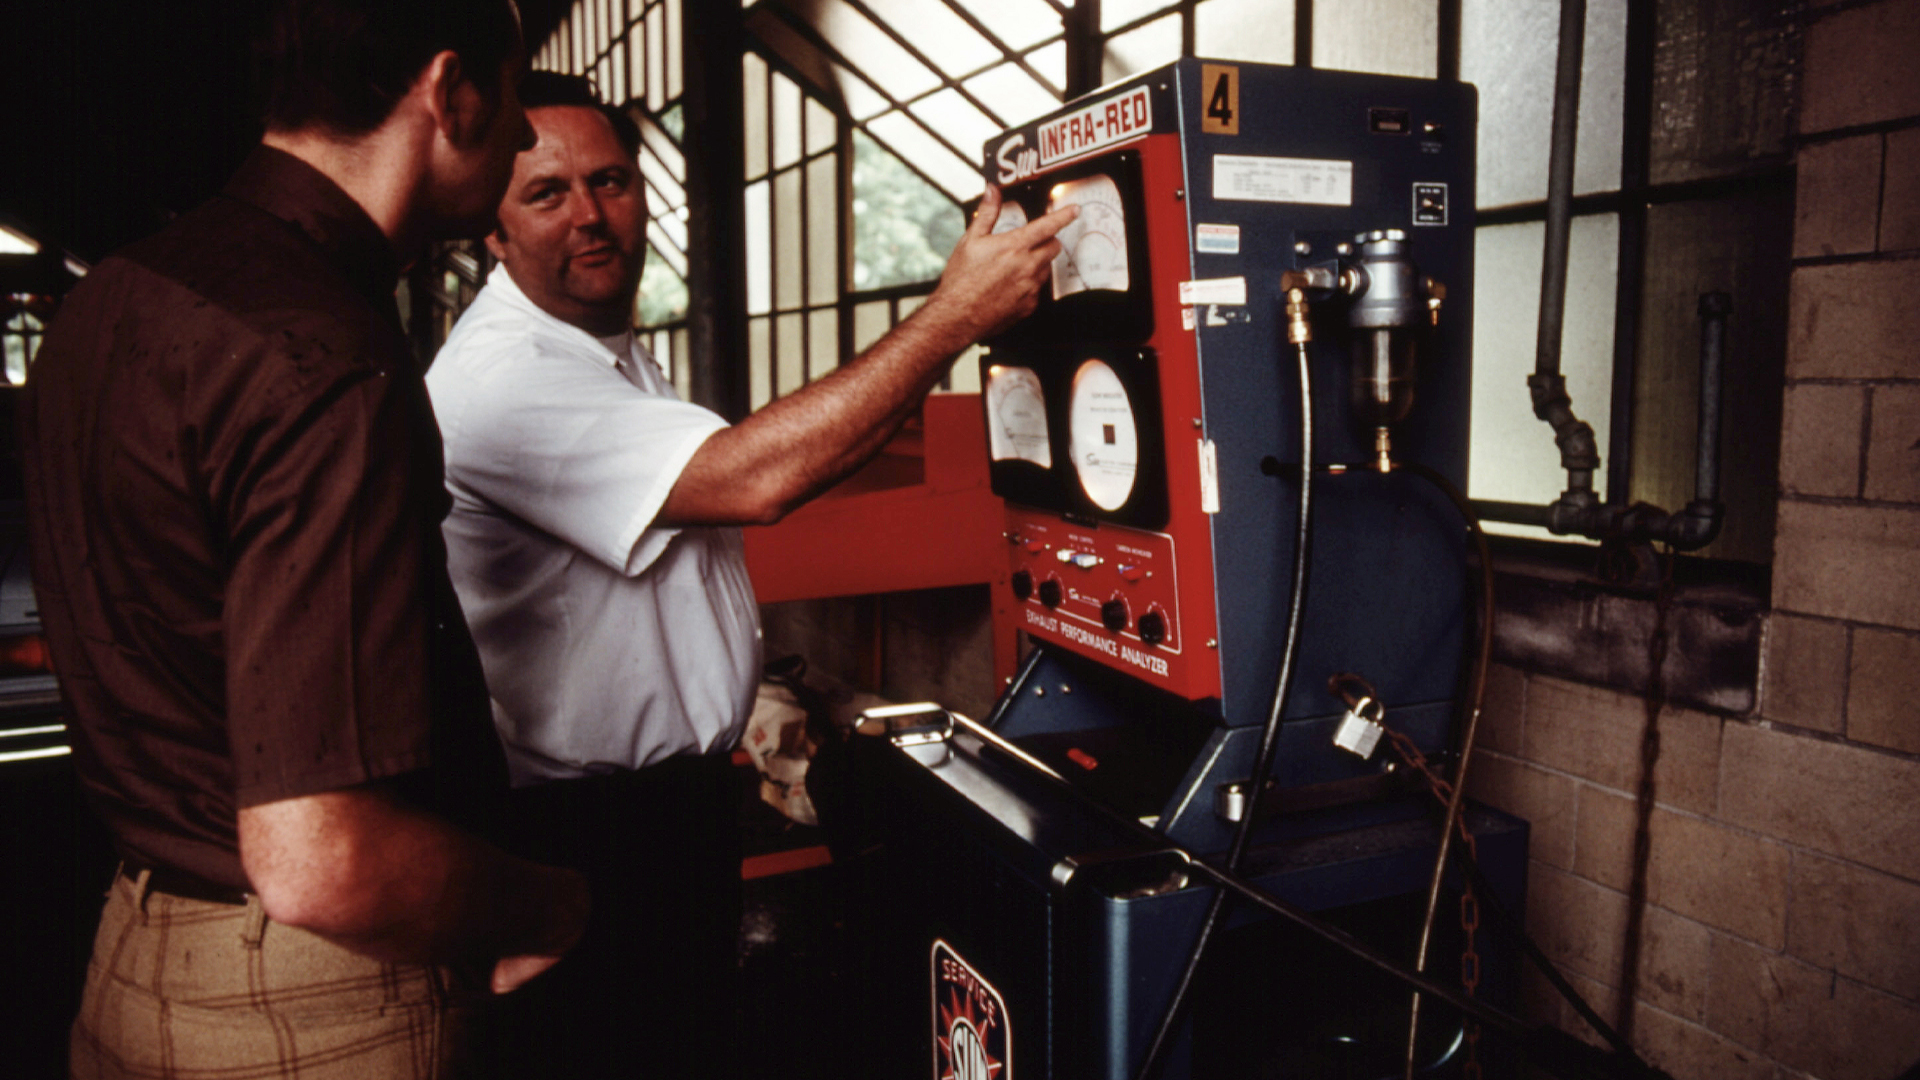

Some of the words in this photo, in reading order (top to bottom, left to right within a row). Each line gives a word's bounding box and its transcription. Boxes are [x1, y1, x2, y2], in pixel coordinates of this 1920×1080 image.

[1208, 73, 1232, 126] 4
[997, 133, 1039, 185] Sun
[1041, 91, 1148, 160] INFRA-RED
[1026, 608, 1058, 632] EXHAUST
[1061, 621, 1119, 657] PERFORMANCE
[1121, 645, 1170, 677] ANALYZER
[942, 958, 996, 1028] SERVICE
[953, 1026, 988, 1080] SUN
